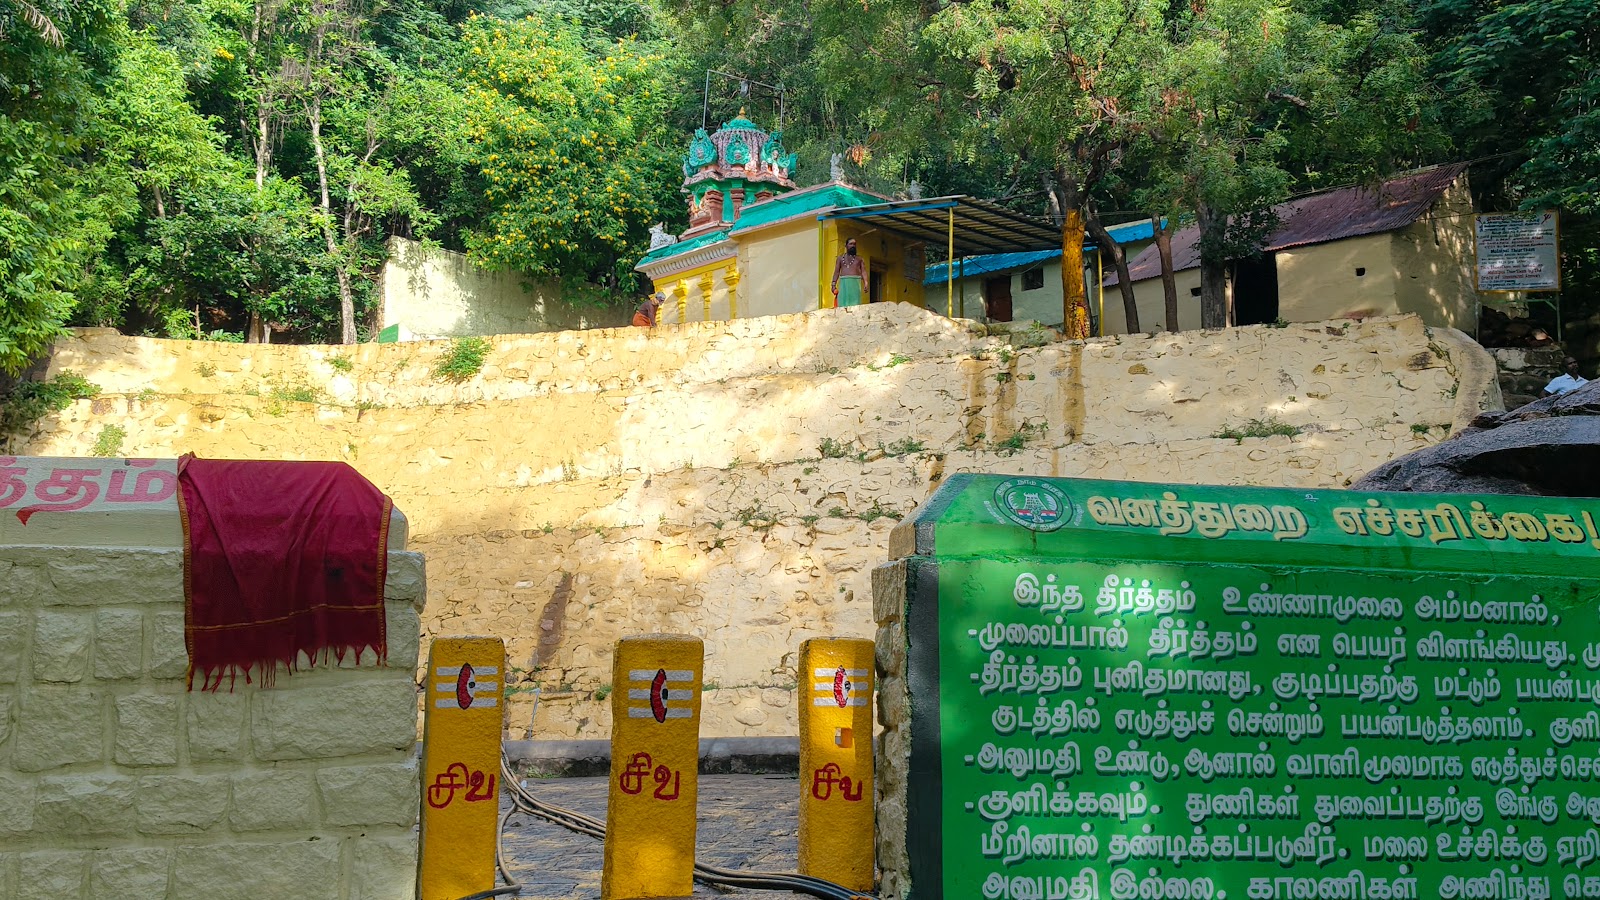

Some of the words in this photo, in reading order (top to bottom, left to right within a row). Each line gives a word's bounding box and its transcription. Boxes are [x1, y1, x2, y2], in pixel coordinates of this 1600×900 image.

[1087, 492, 1307, 540] வனத்துறை
[1014, 573, 1083, 613] இந்த
[1095, 574, 1195, 615] தீர்த்தம்
[1222, 583, 1402, 620] உண்ணாமுலை
[1415, 590, 1558, 625] அம்மனால்,
[1147, 616, 1256, 659] தீர்த்தம்
[1277, 634, 1320, 654] என
[1333, 627, 1406, 663] பெயர்
[1417, 630, 1575, 667] விளங்கியது.
[1094, 660, 1260, 699] புனிதமானது,
[1272, 664, 1418, 701] குடிப்பதற்கு
[1434, 668, 1500, 702] மட்டும்
[992, 697, 1100, 735] குடத்தில்
[1115, 700, 1214, 738] எடுத்துச்
[1228, 702, 1323, 741] சென்றும்
[1341, 705, 1533, 742] பயன்படுத்தலாம்.
[427, 762, 495, 809] சிவ
[620, 752, 681, 801] சிவ
[812, 762, 863, 801] சிவ
[1286, 747, 1360, 775] வாளி
[1364, 756, 1463, 781] மூலமாக
[1471, 748, 1557, 784] எடுத்துச்
[1186, 785, 1299, 822] துணிகள்
[1314, 786, 1483, 823] துவைப்பதற்கு
[1496, 785, 1558, 821] இங்கு
[982, 821, 1098, 865] மீறினால்
[1107, 822, 1346, 864] தண்டிக்கப்படுவீர்.
[1364, 836, 1428, 857] மலை
[1436, 825, 1547, 862] உச்சிக்கு
